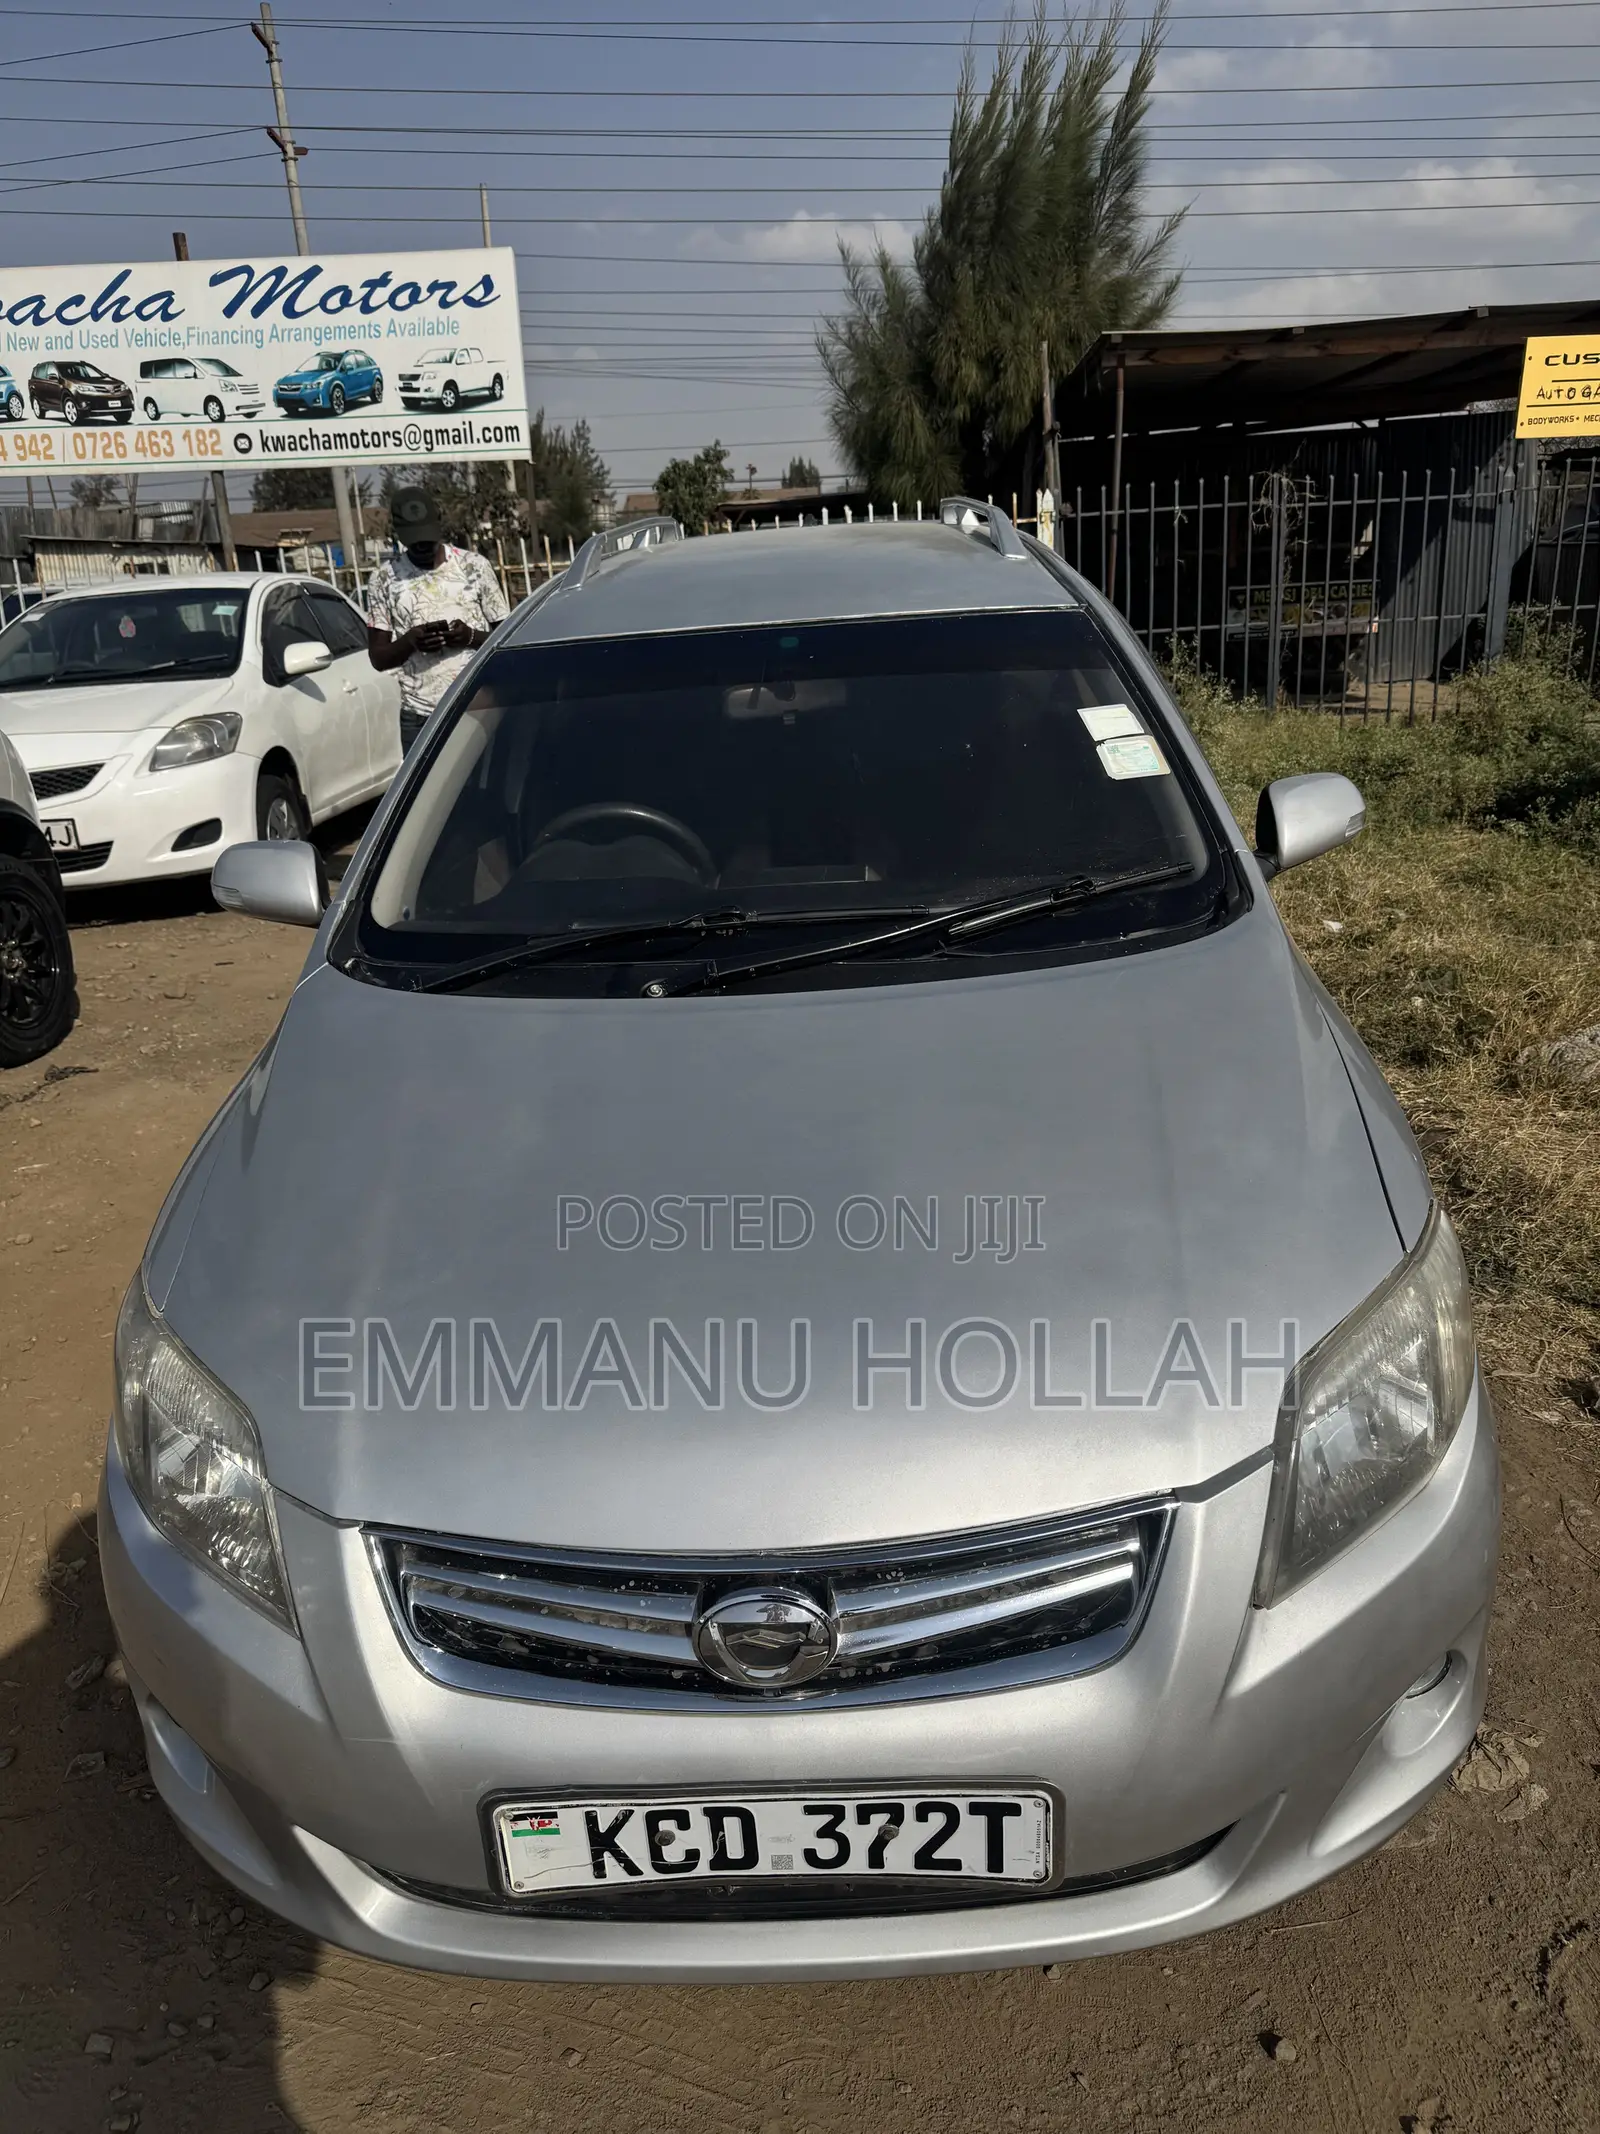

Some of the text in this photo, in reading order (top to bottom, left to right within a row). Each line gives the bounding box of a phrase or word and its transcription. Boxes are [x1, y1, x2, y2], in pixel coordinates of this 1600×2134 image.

[0, 264, 501, 326] acha Motors
[6, 330, 40, 352] New
[45, 331, 74, 350] and
[78, 327, 119, 349] Used
[268, 322, 382, 347] Arrangements
[386, 315, 461, 338] Available
[13, 432, 56, 462] 942
[72, 431, 128, 460] 0726
[134, 430, 175, 458] 463
[182, 428, 223, 457] 182
[259, 420, 522, 453] kwachamotors@gmail.com
[1528, 415, 1574, 425] BODYWORKS
[583, 1806, 759, 1879] KCD
[802, 1800, 1023, 1873] 372T
